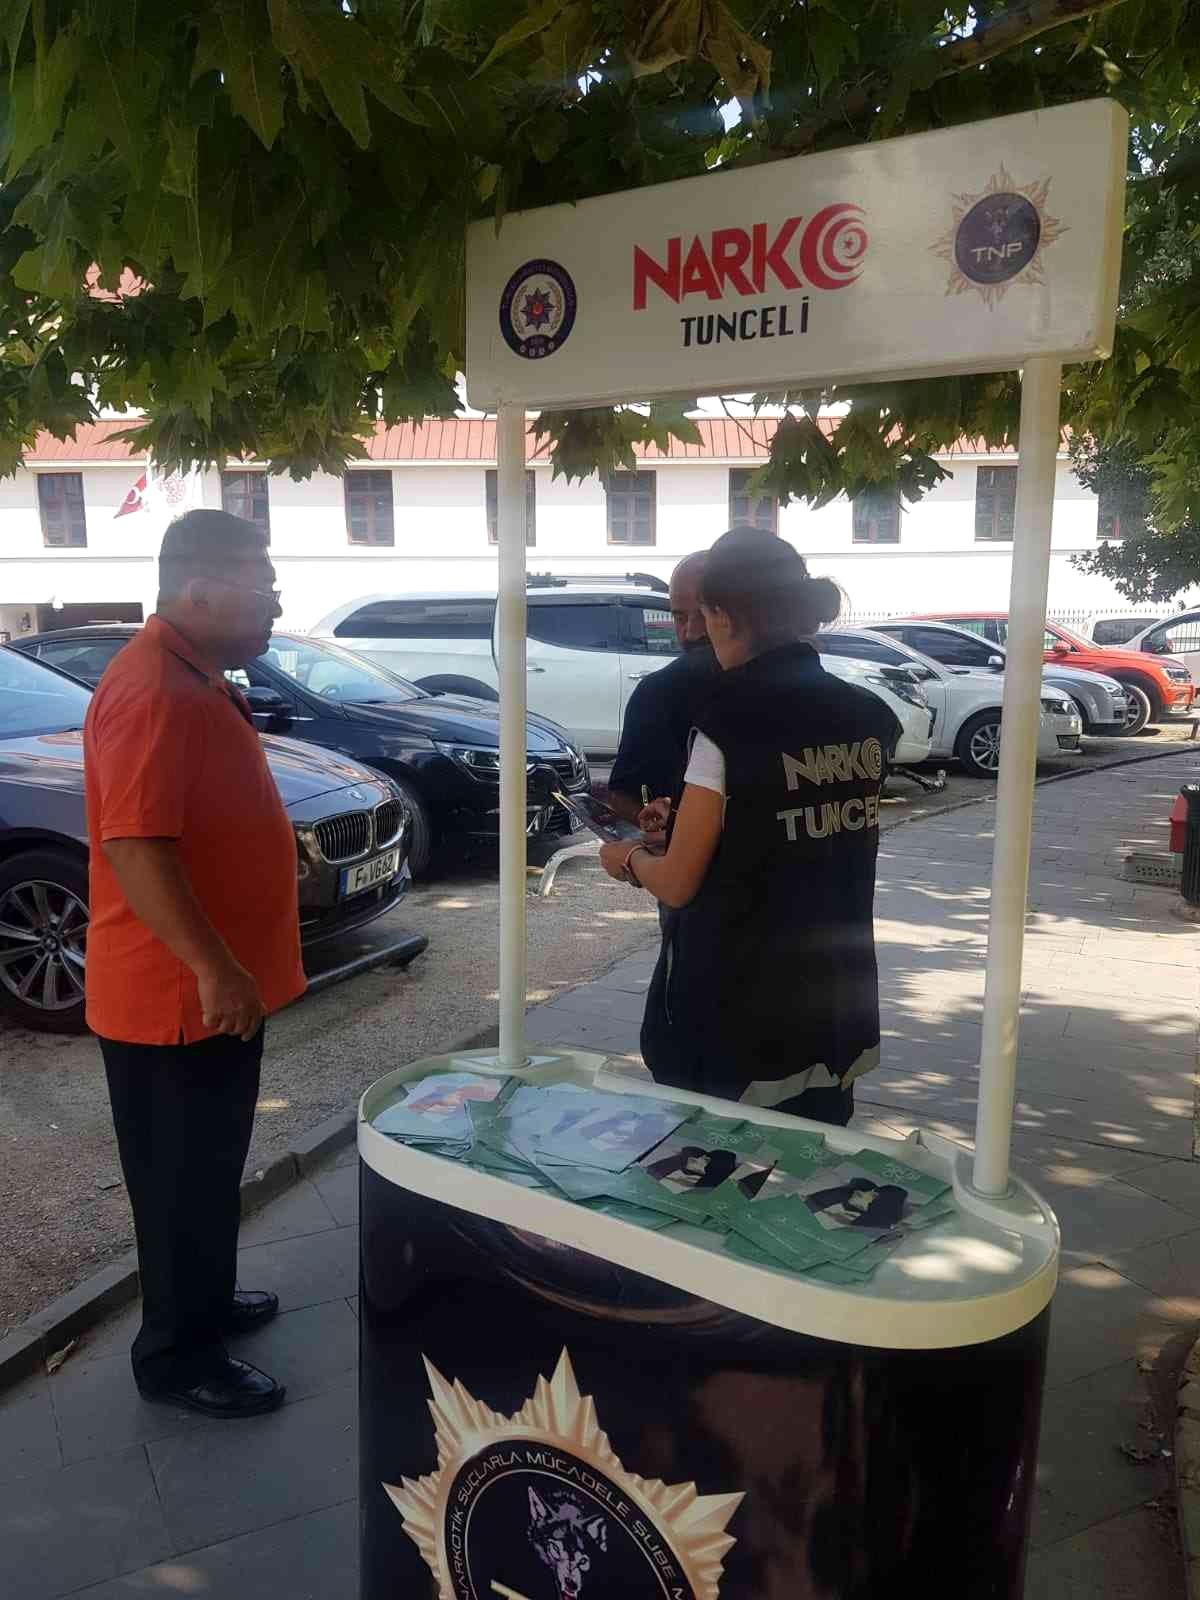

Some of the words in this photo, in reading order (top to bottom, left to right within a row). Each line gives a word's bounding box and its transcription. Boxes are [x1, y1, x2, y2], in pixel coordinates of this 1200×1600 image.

[970, 241, 1023, 263] TNP
[680, 296, 809, 347] TUNCELİ
[525, 1450, 631, 1519] MÜCADELE
